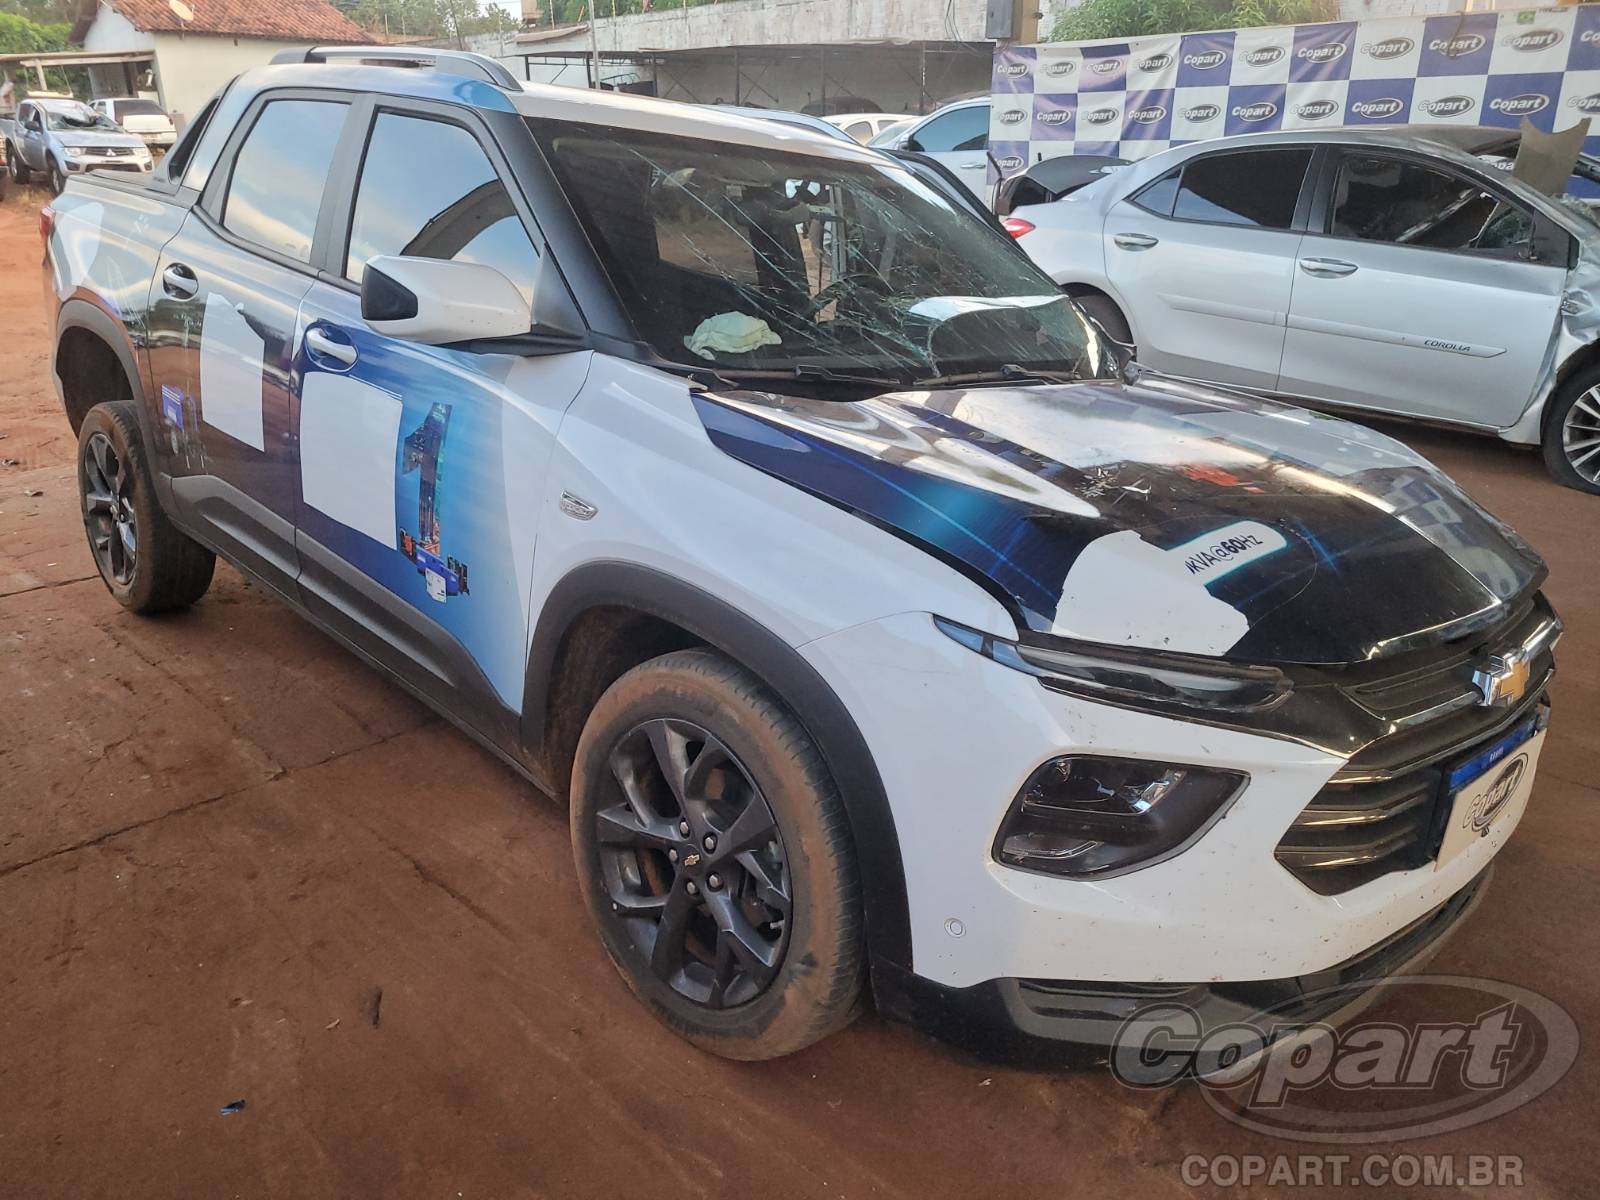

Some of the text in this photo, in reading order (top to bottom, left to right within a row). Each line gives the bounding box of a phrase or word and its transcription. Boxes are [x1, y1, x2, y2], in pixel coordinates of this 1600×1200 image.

[1298, 44, 1340, 58] Copart
[1360, 42, 1405, 55] Copart
[1184, 51, 1220, 65] Copart
[998, 63, 1026, 75] Copart
[1232, 104, 1270, 118] Copart
[1290, 102, 1330, 115] Copart
[1352, 100, 1396, 113] Copart
[1418, 98, 1466, 112] Copart
[1489, 97, 1541, 111] Copart
[1037, 110, 1067, 123] Copart
[1128, 108, 1161, 122] Copart
[1424, 339, 1471, 352] COROLLA
[1462, 765, 1520, 831] Copart
